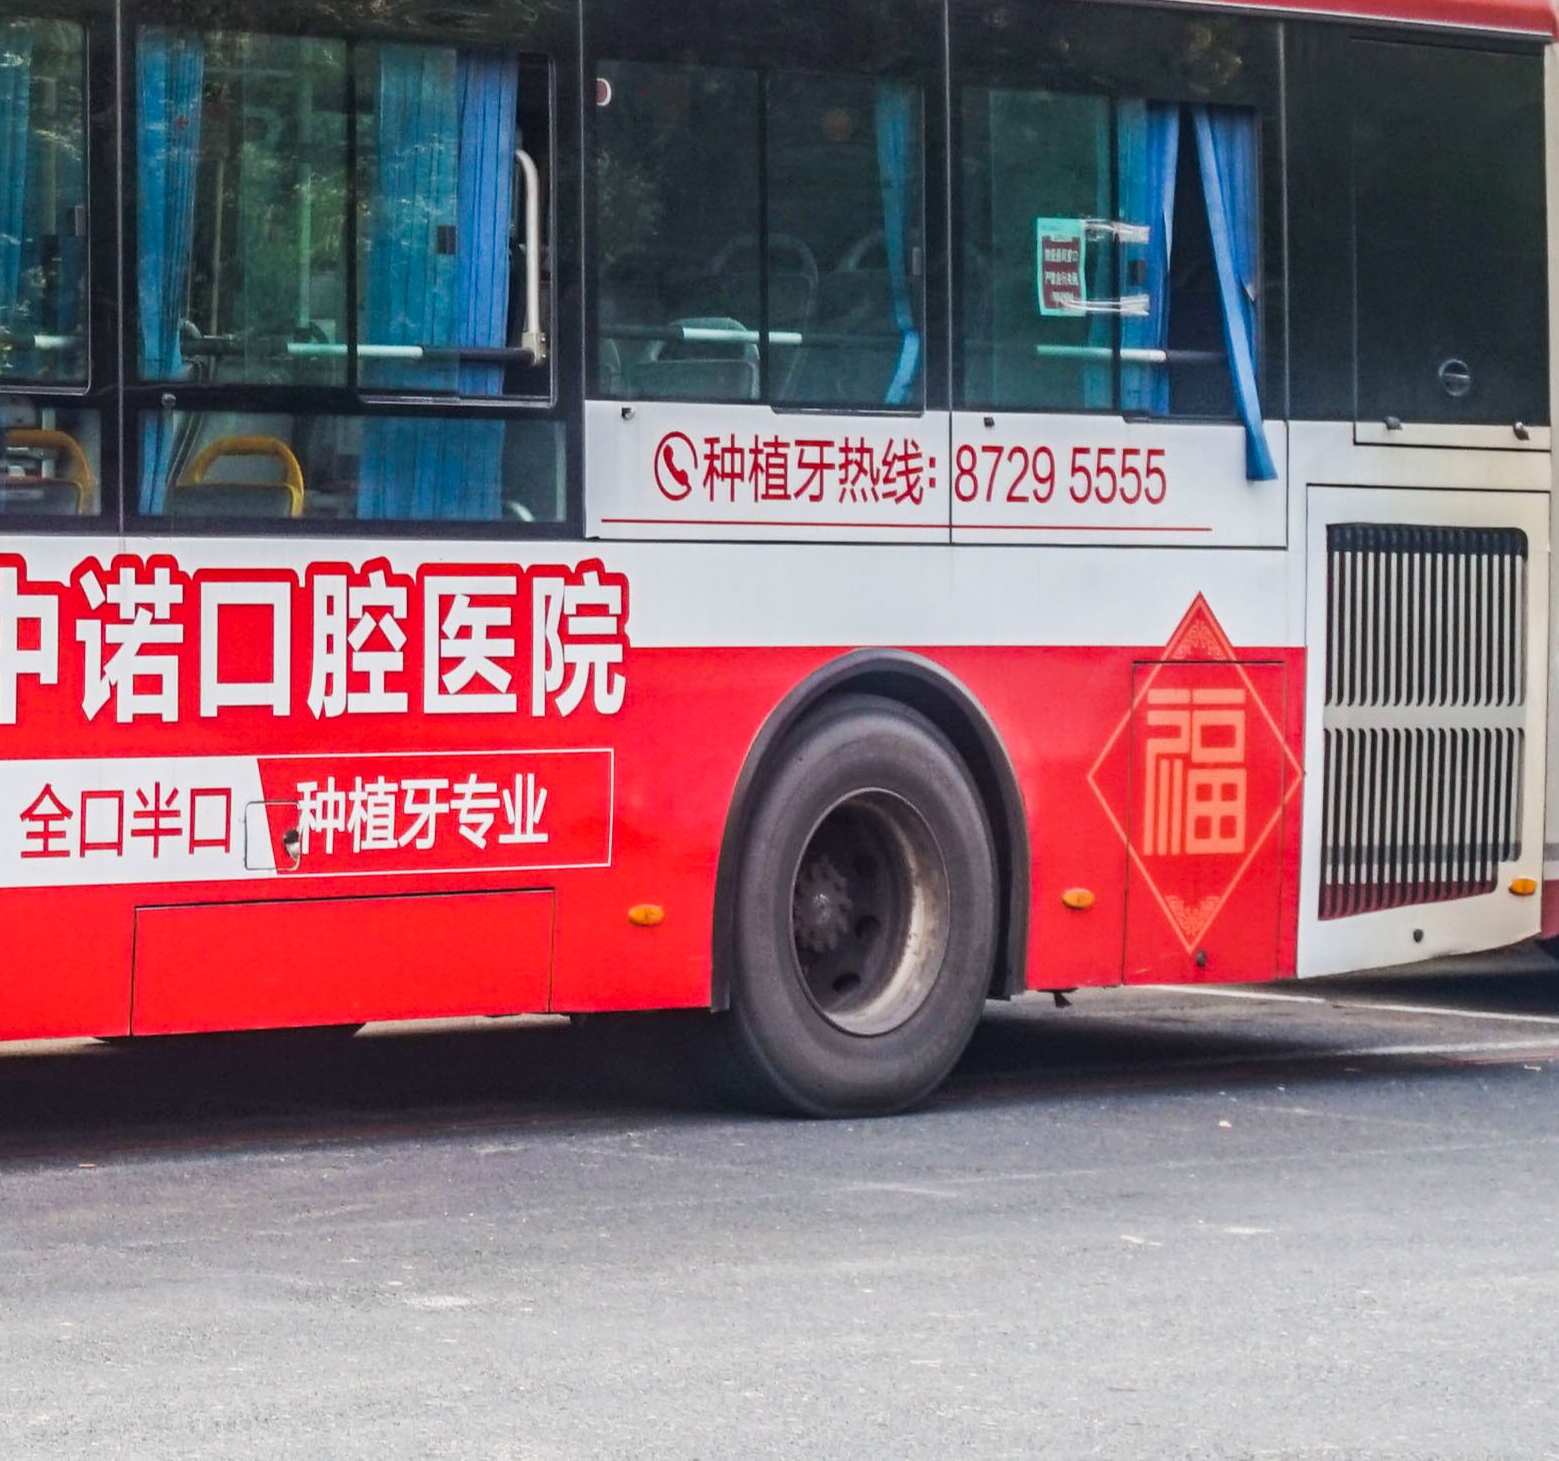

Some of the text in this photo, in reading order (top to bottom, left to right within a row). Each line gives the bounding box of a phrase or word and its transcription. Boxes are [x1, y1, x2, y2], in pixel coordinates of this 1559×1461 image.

[954, 444, 1056, 504] 8729
[1068, 446, 1167, 505] 5555
[1143, 687, 1247, 856] 福
[19, 773, 549, 859] 全口半口 种植牙专业
